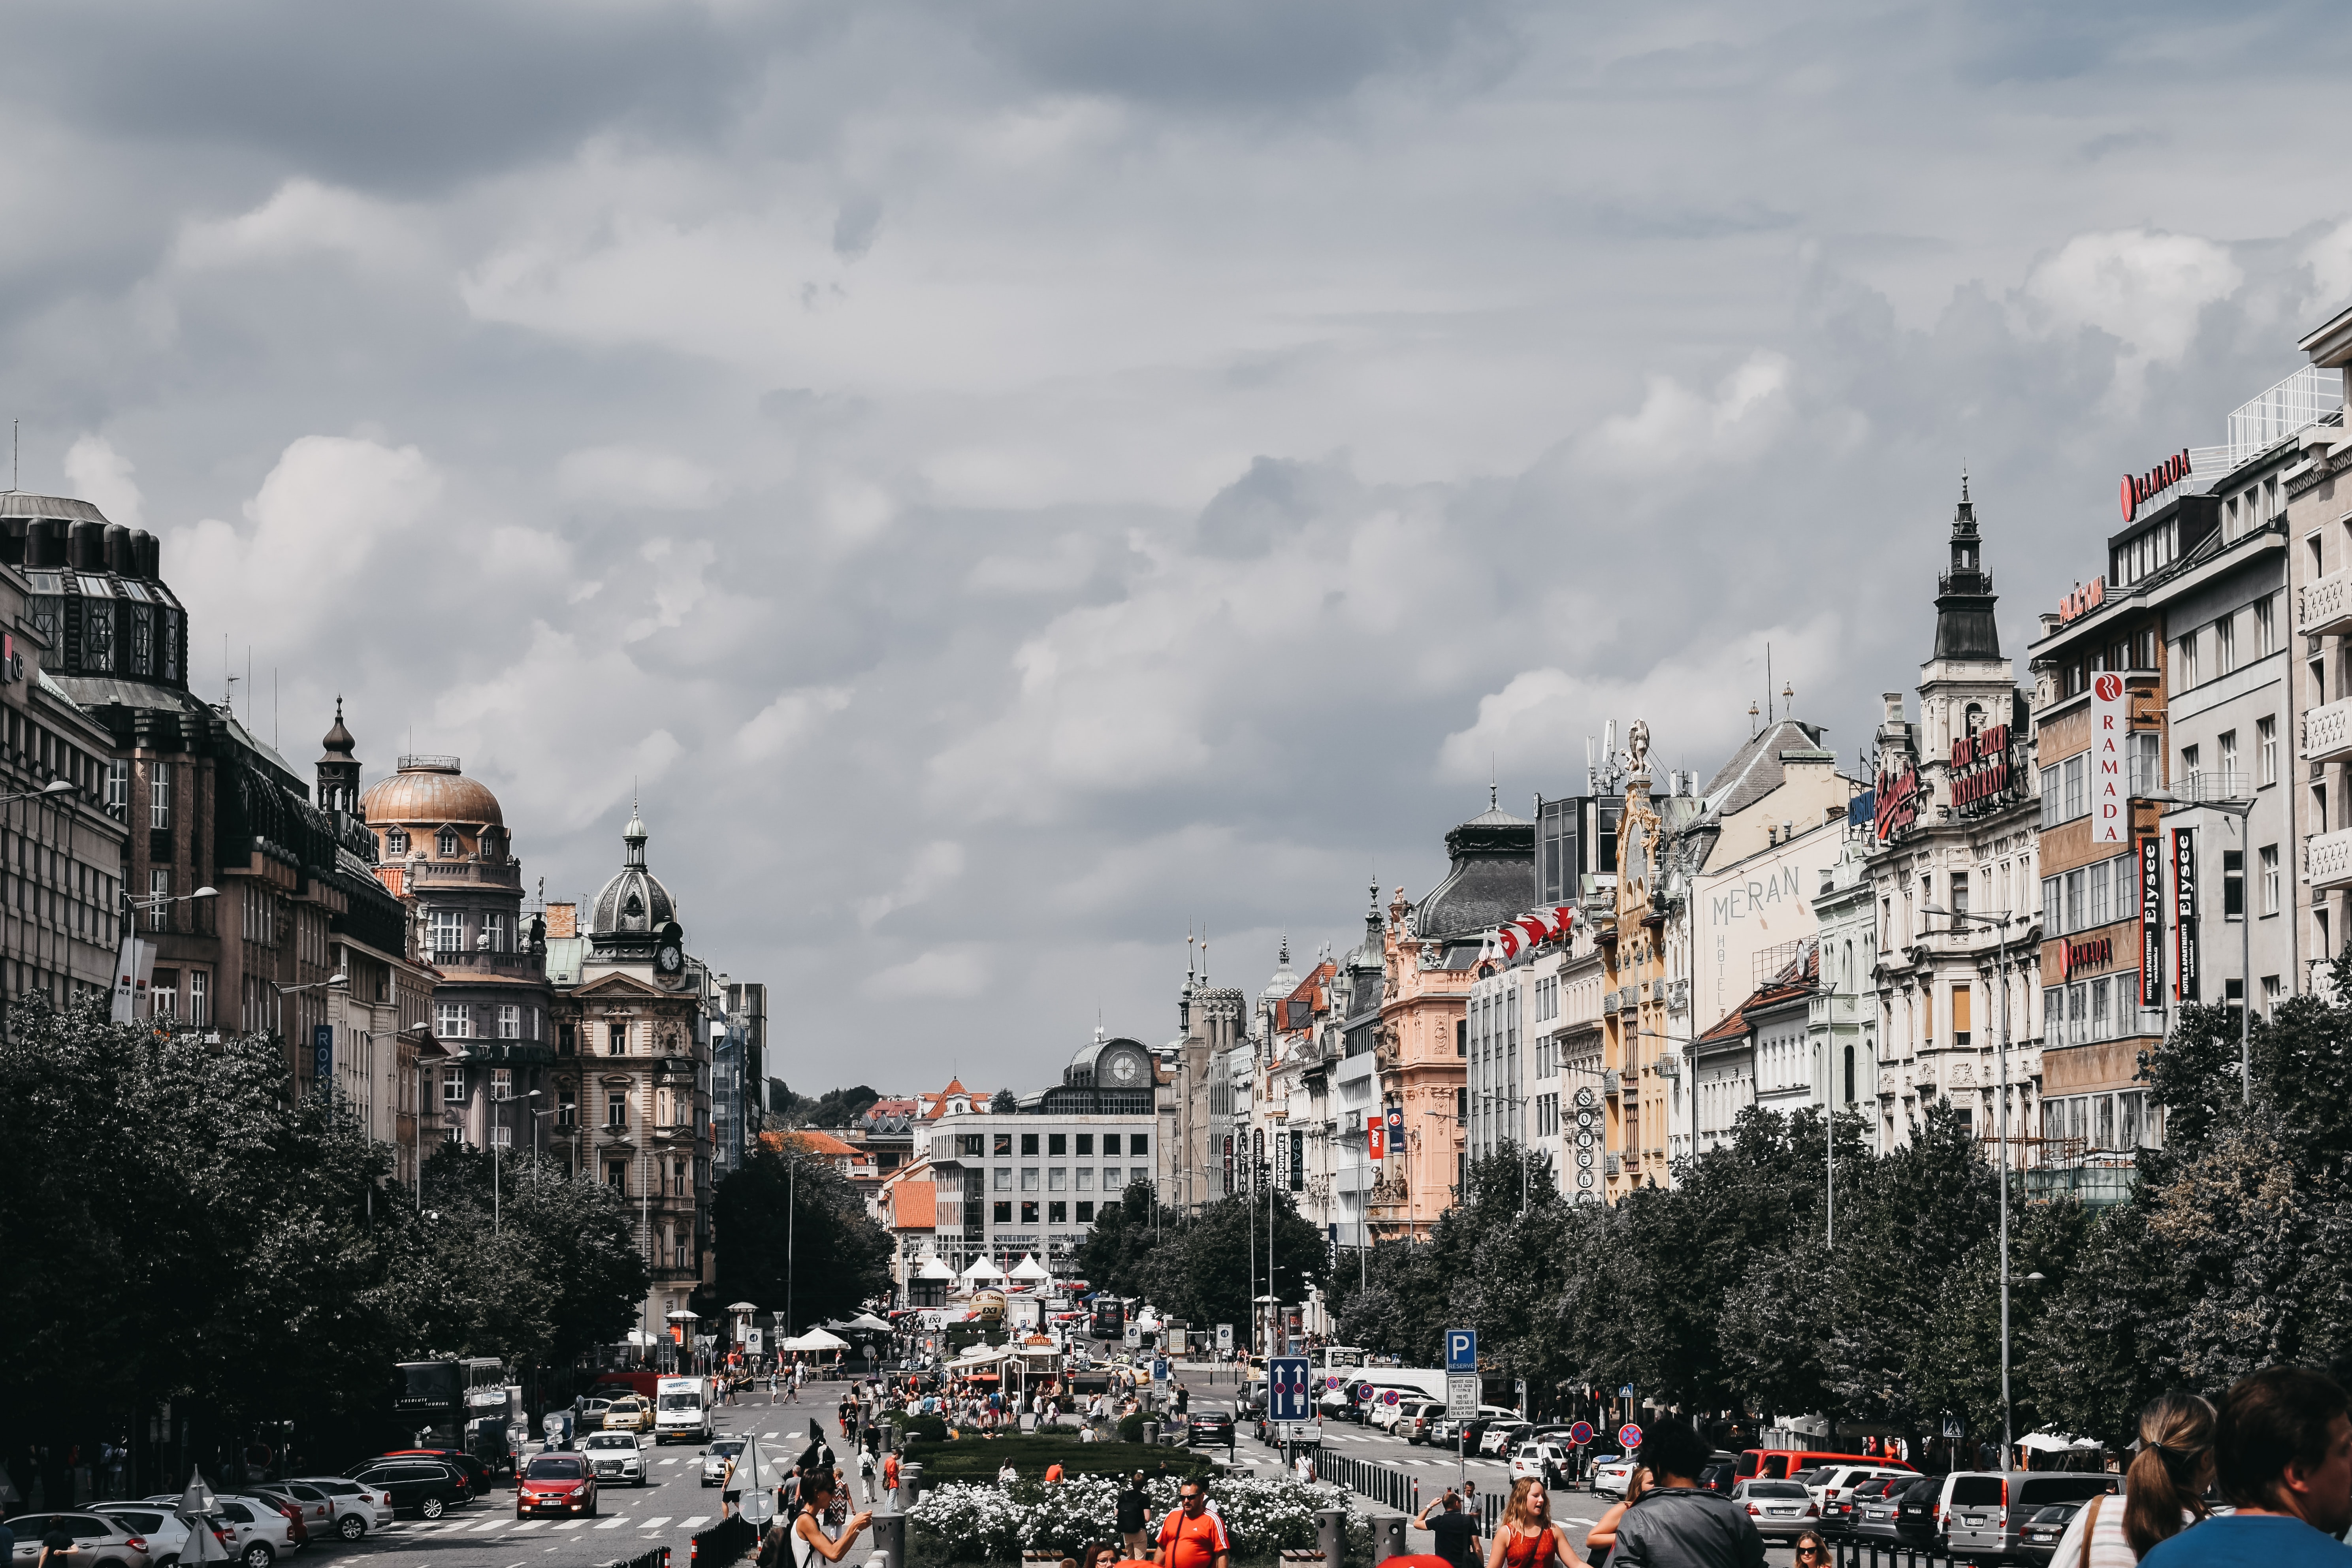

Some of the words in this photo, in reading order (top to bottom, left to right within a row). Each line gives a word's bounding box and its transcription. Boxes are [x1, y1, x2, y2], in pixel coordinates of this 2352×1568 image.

[2135, 448, 2191, 504] RAMADA
[2085, 575, 2104, 612] KNIH
[13, 652, 24, 680] KB
[1980, 725, 2004, 757] CZECH
[2101, 715, 2118, 840] RAMADA
[1713, 866, 1799, 925] MERAN
[2145, 845, 2159, 924] Elysee
[2179, 835, 2193, 916] Elysee
[2070, 937, 2110, 967] RAMADA
[1293, 1139, 1301, 1181] GATE
[1580, 1092, 1590, 1186] HOTEL
[1157, 1363, 1164, 1373] P
[1453, 1335, 1469, 1360] P
